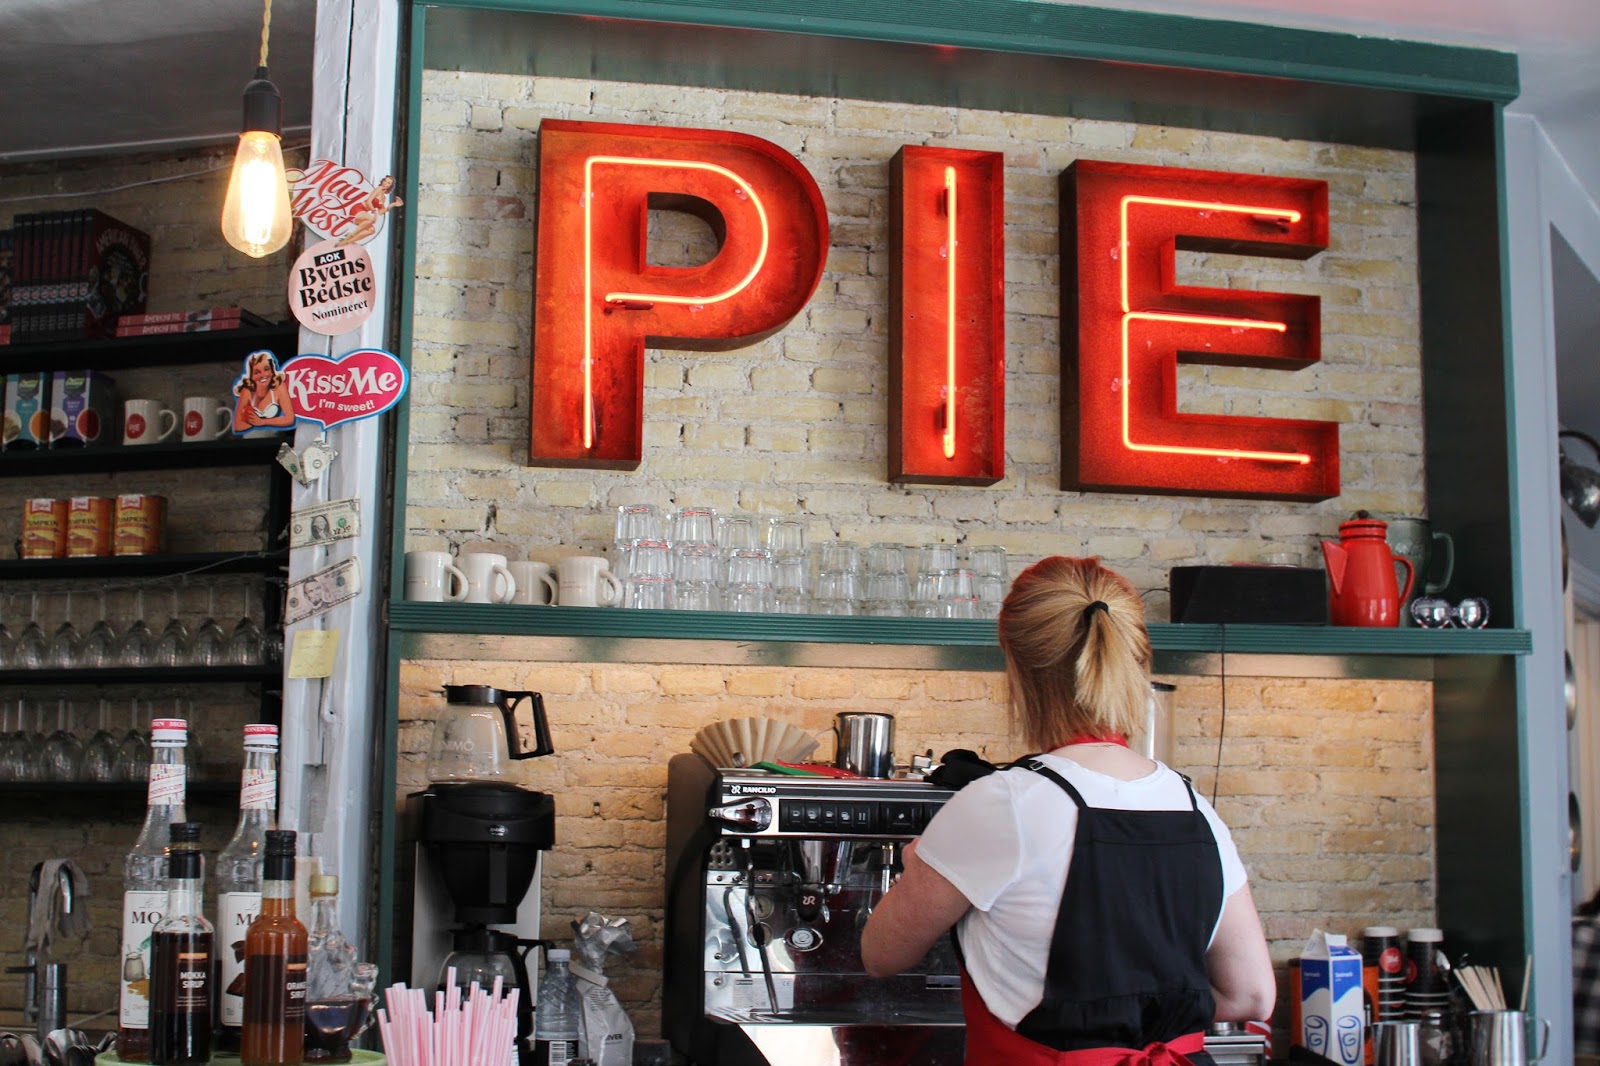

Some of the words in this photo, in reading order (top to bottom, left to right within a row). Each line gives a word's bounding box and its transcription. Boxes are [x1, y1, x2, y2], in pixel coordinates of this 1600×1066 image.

[285, 158, 369, 212] May
[287, 186, 359, 238] West
[320, 252, 341, 265] AOK
[299, 258, 366, 292] Byens
[299, 276, 372, 309] Bedste
[312, 300, 369, 323] Nomineret
[527, 117, 1341, 502] PIE
[318, 399, 335, 410] I'm
[337, 399, 375, 412] sweet!
[129, 423, 141, 432] PIE
[187, 420, 198, 429] PIE
[742, 786, 777, 795] RANCILIO
[236, 913, 260, 926] M
[180, 971, 207, 980] MOKKA
[182, 980, 205, 989] SIRUP
